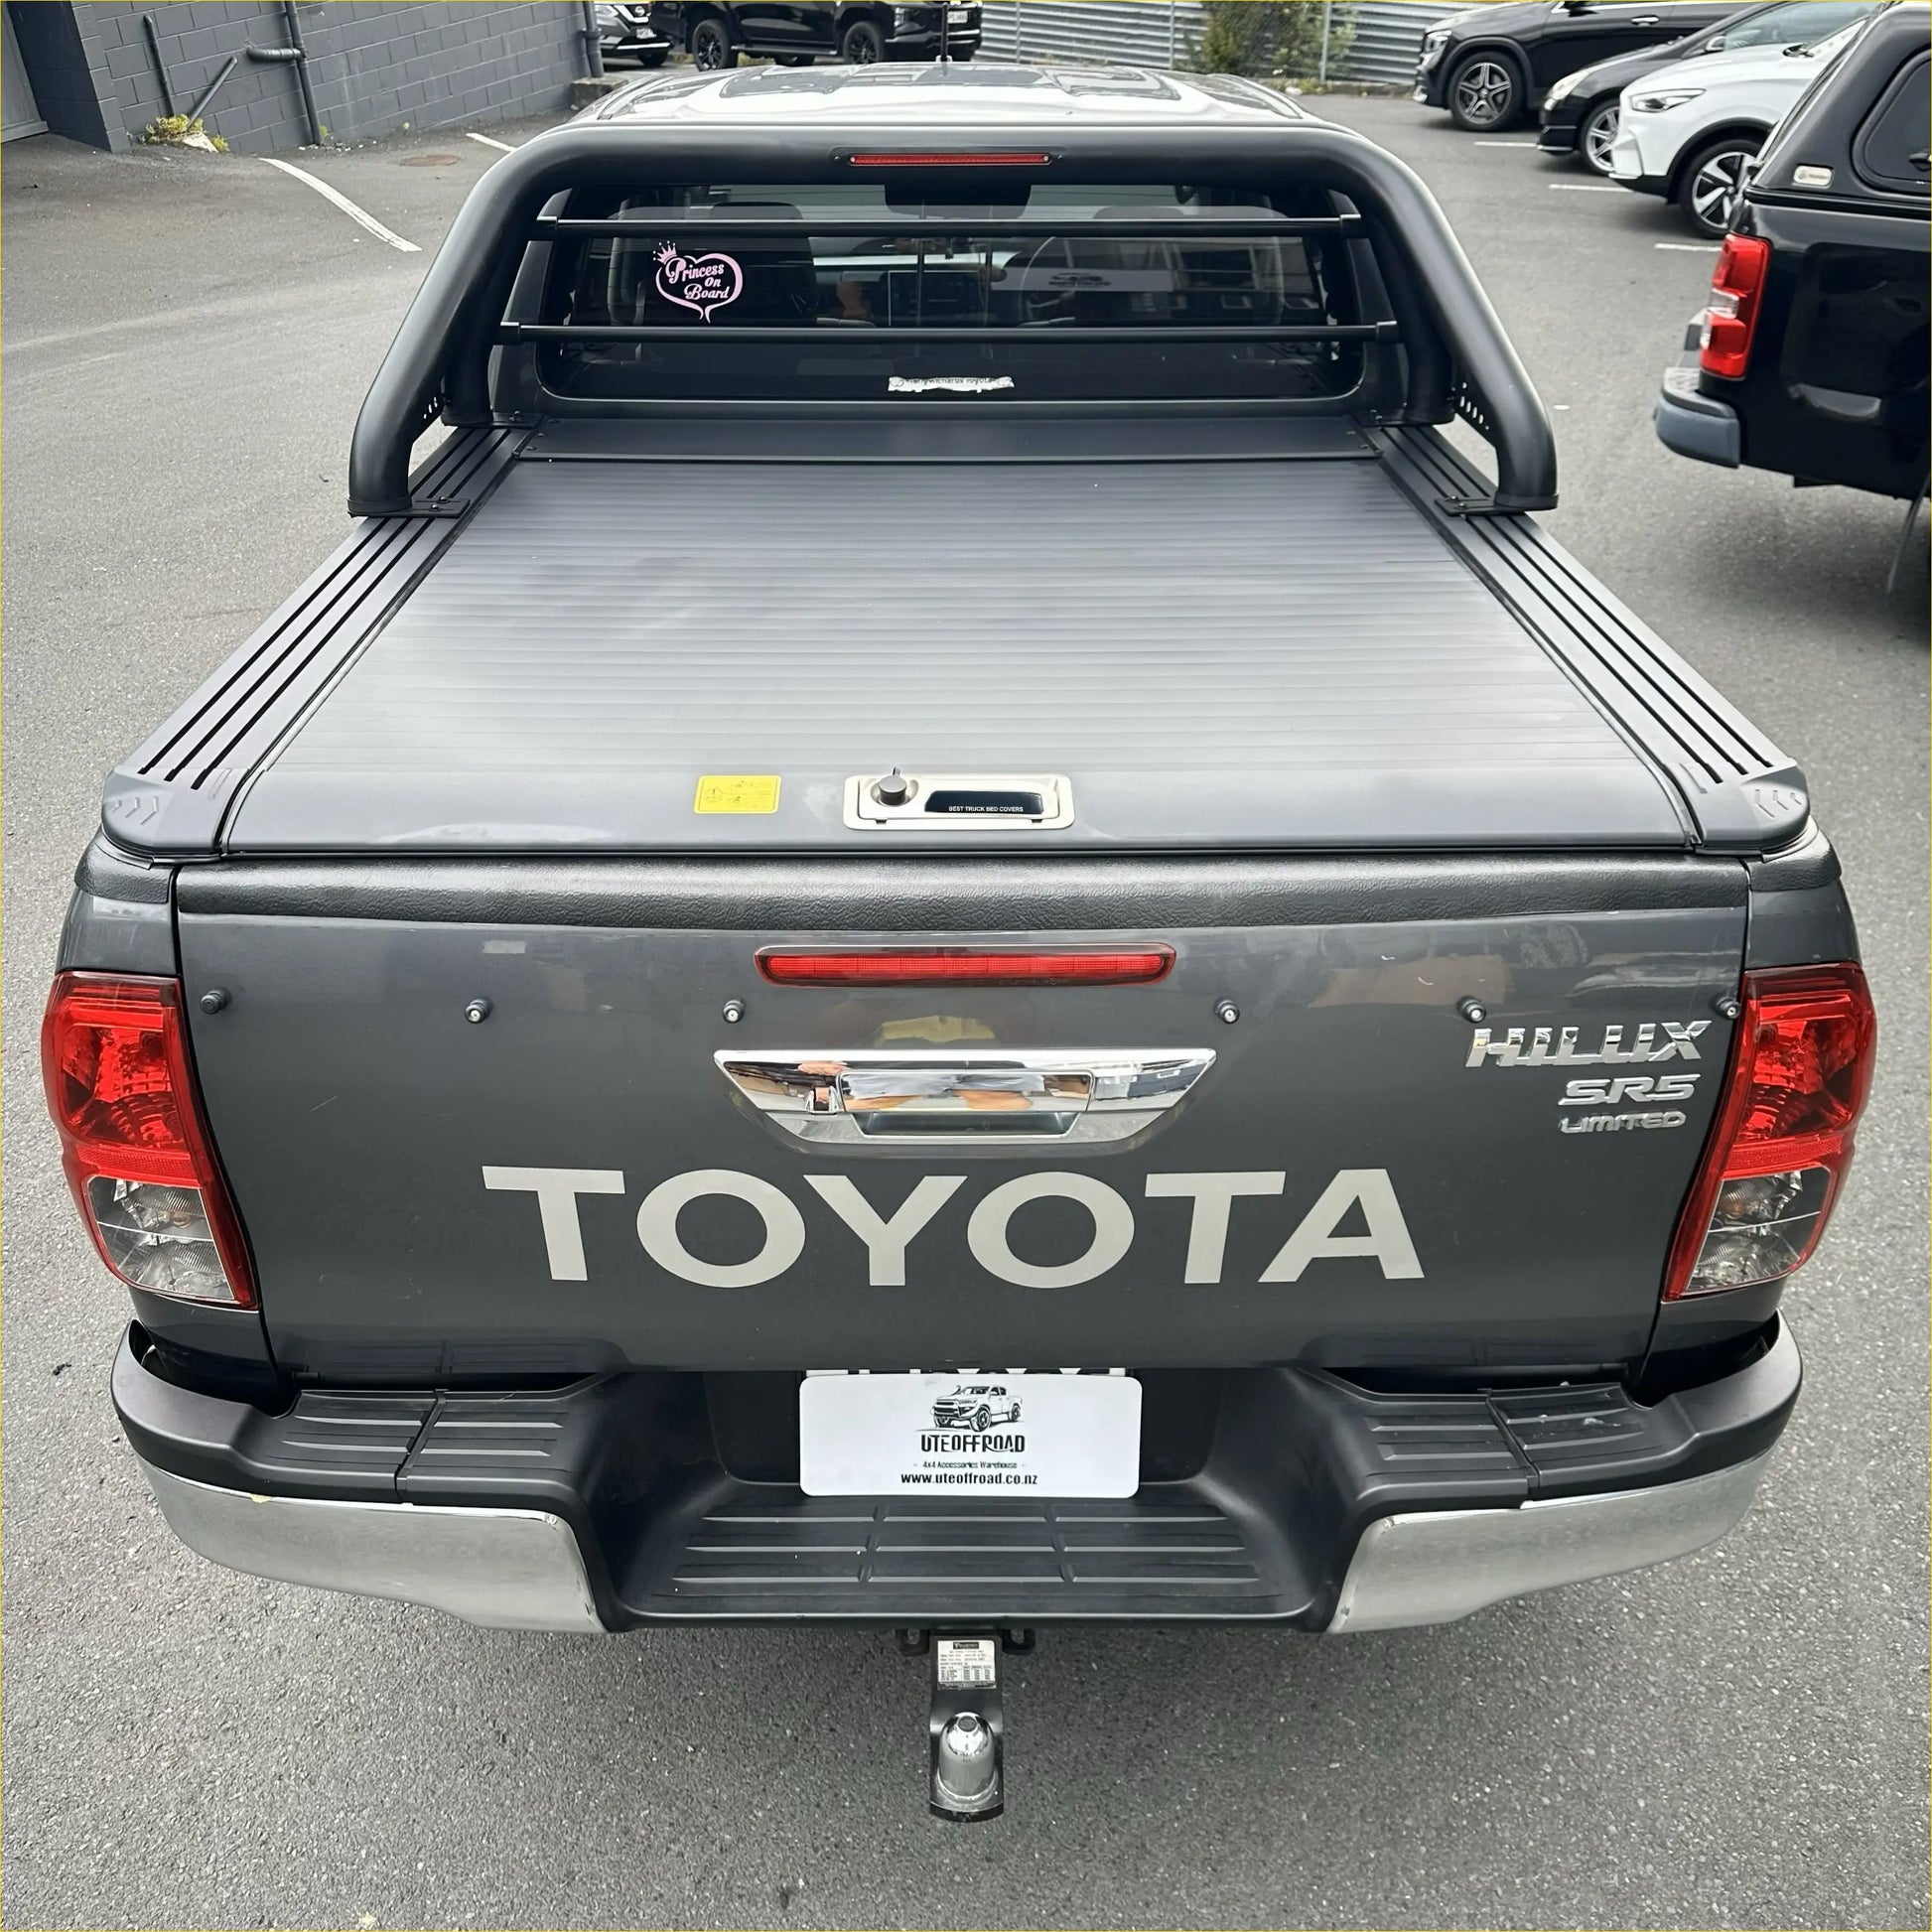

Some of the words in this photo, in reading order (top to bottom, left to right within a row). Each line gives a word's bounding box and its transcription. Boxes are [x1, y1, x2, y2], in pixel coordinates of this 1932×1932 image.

[665, 258, 724, 284] Princess
[684, 284, 730, 300] Board
[1465, 1020, 1713, 1068] HILUX
[1557, 1073, 1702, 1106] SR5
[1558, 1110, 1687, 1134] LIMITED
[482, 1166, 1425, 1289] TOYOTA
[922, 1460, 936, 1469] 4x4
[937, 1460, 979, 1469] Accessories
[979, 1460, 1018, 1469] Warehouse
[900, 1471, 1038, 1485] www.uteoffroad.co.nz
